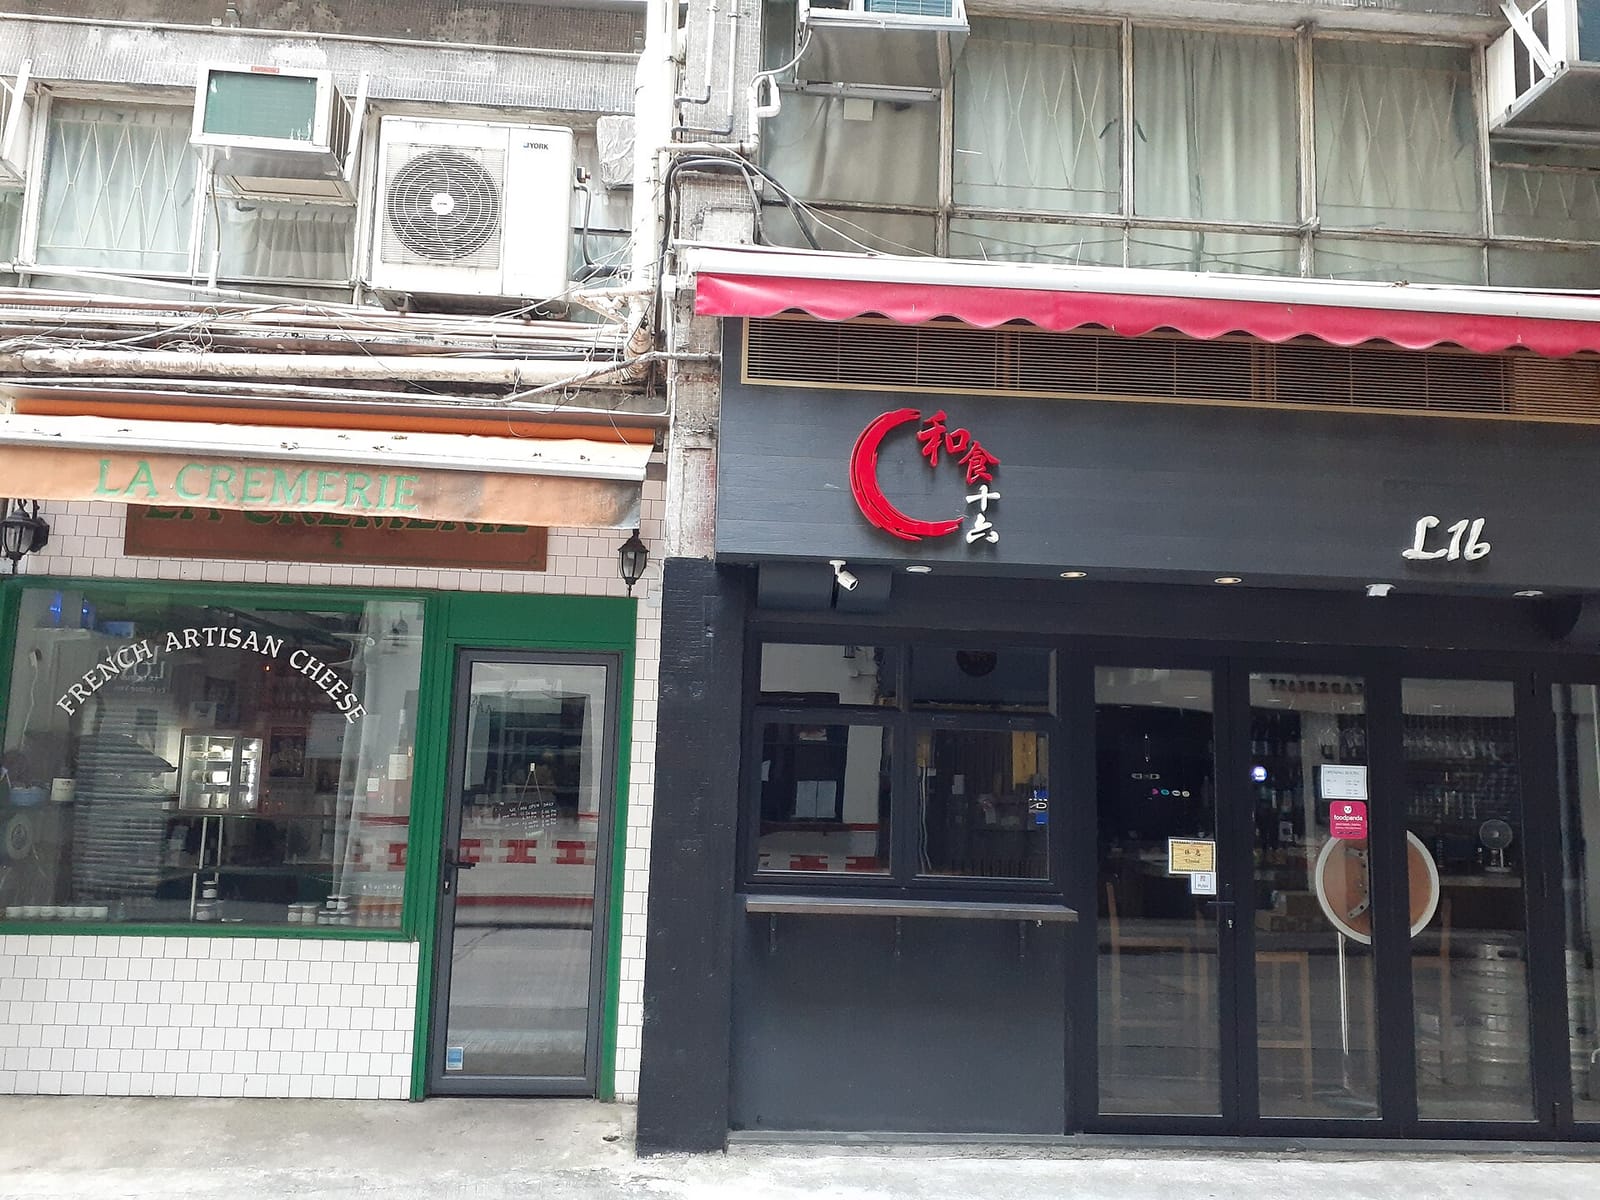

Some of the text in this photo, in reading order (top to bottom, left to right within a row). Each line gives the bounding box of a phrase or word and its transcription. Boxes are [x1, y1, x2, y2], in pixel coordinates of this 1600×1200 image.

[529, 142, 549, 150] YORK
[93, 459, 421, 512] LA CREMERIE
[1401, 515, 1491, 561] L16
[56, 639, 154, 717] FRENCH
[165, 626, 284, 658] ARTISAN
[290, 649, 367, 725] CHEESE
[1333, 814, 1363, 823] foodpanda
